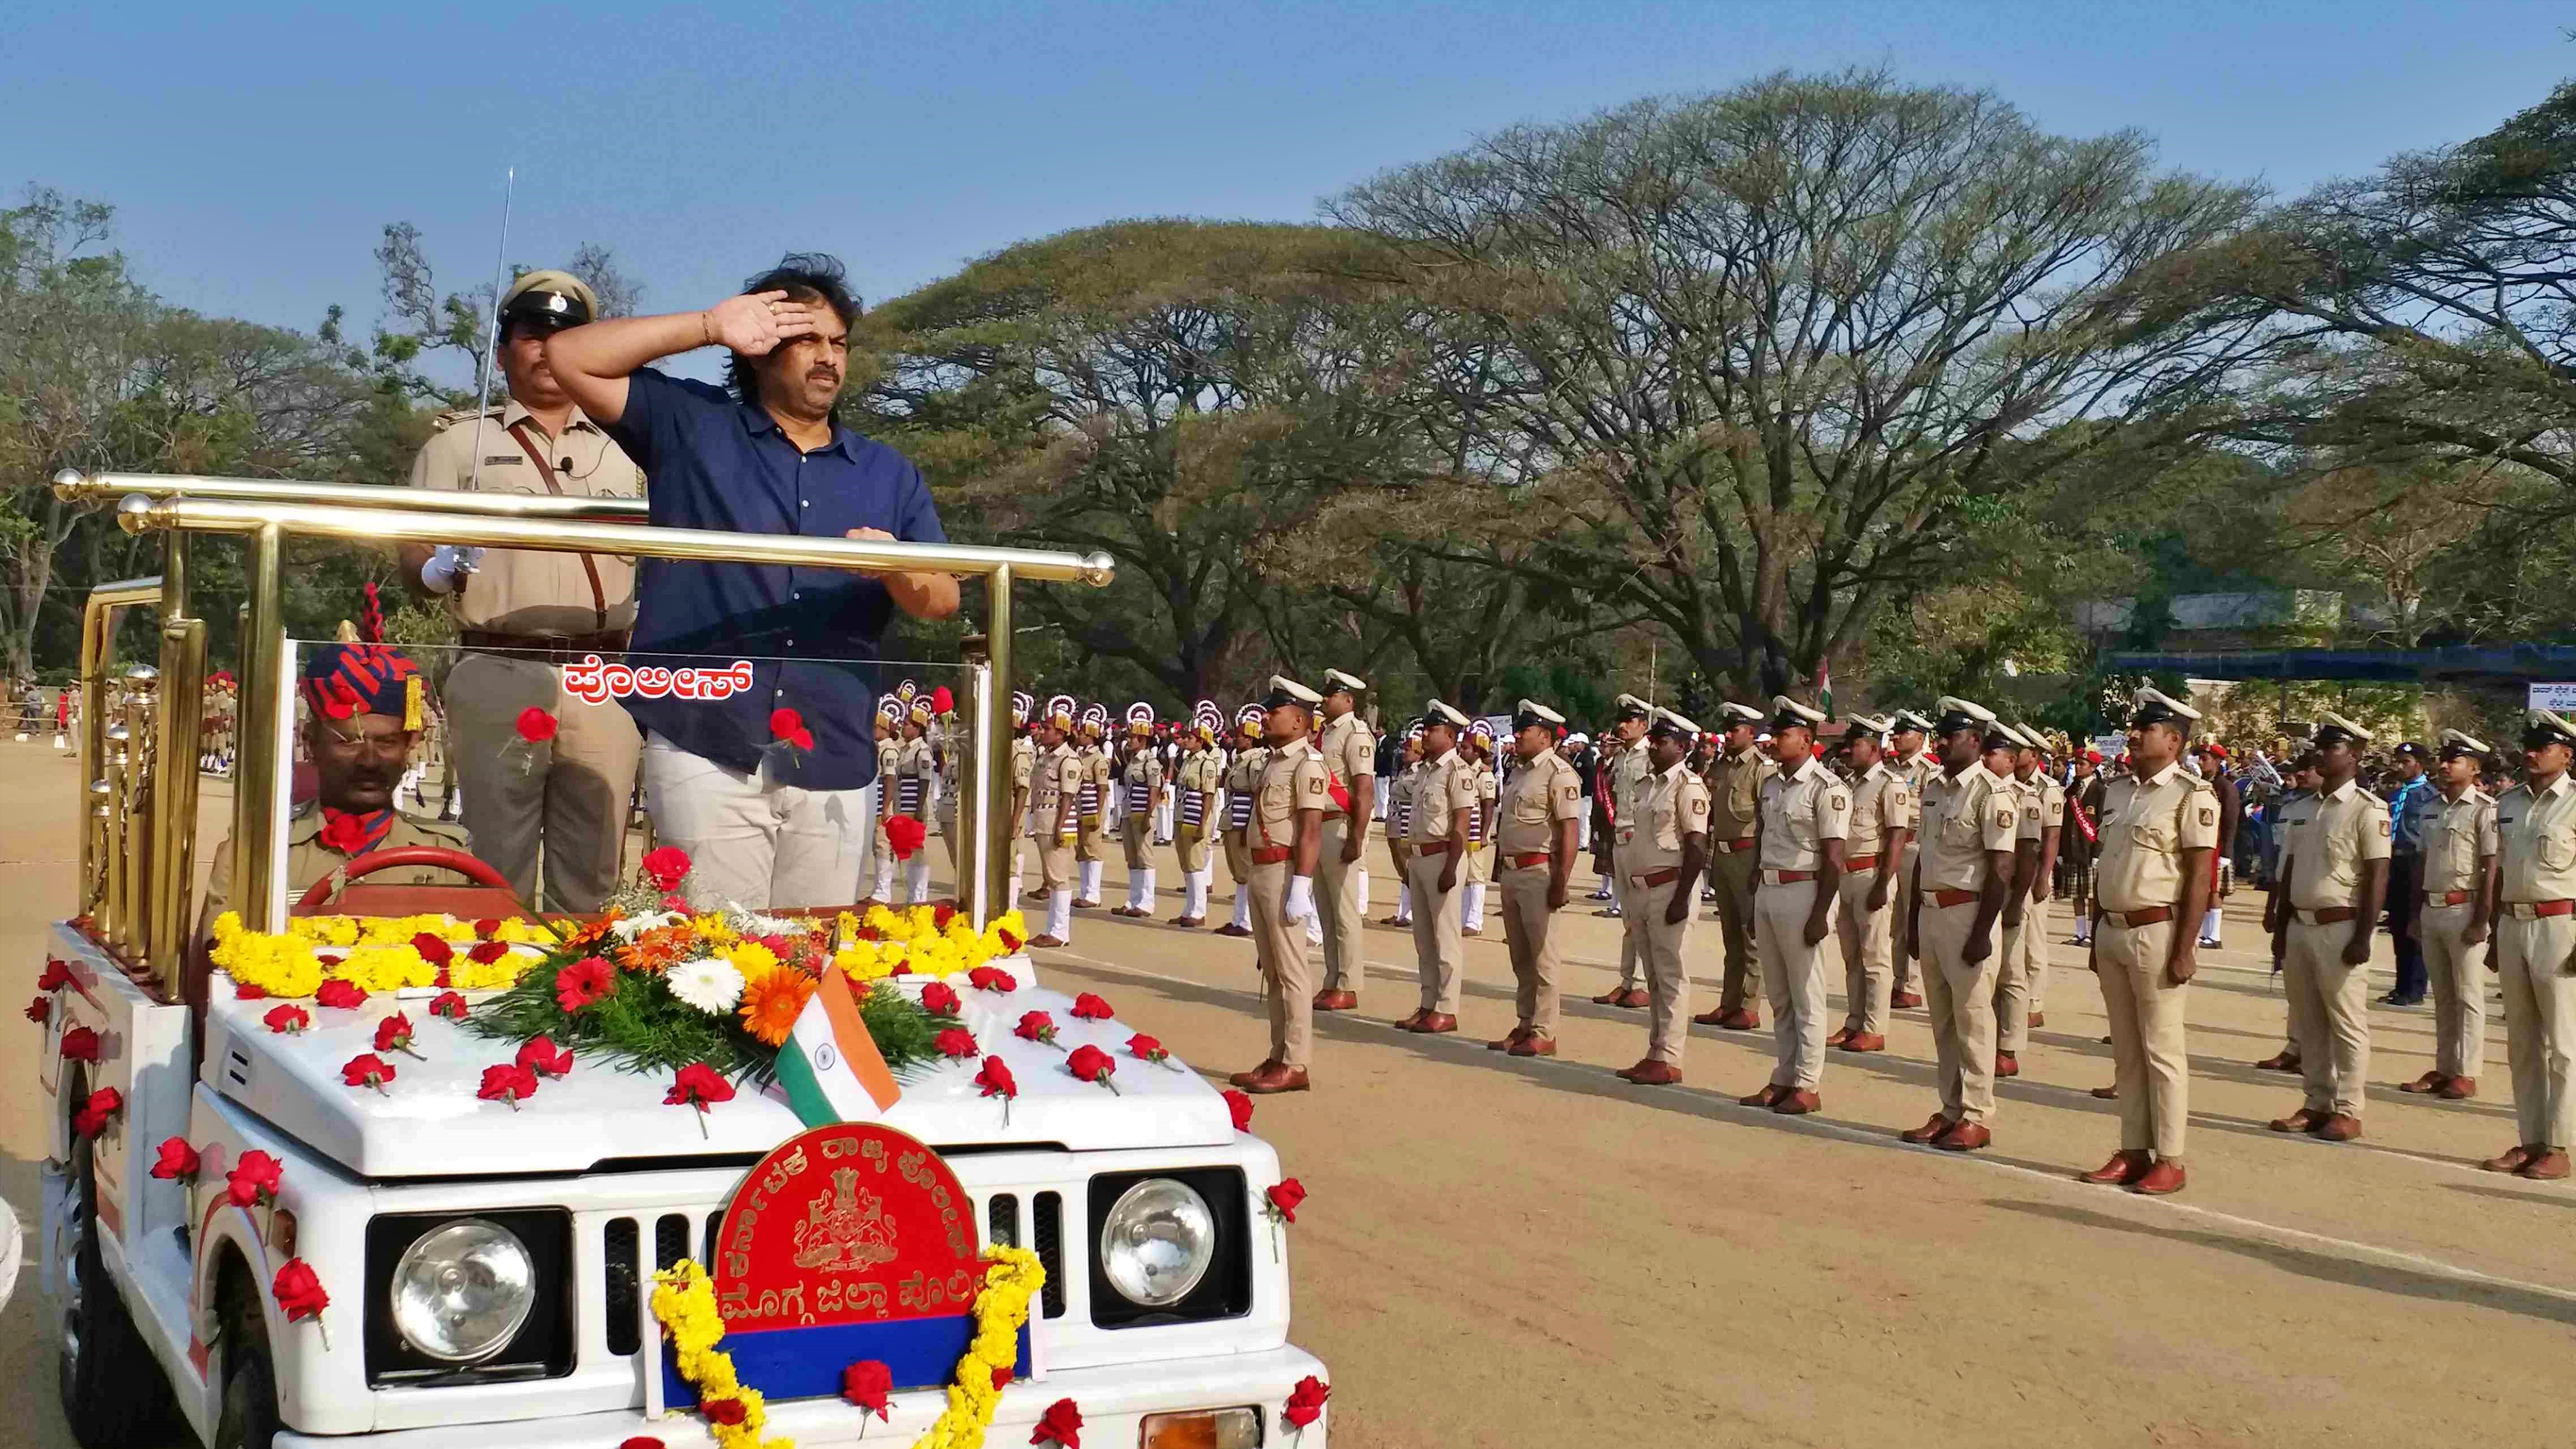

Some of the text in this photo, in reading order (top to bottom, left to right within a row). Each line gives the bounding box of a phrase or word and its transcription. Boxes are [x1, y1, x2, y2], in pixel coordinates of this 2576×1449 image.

[562, 654, 753, 706] ಪೊಲೀಸ್
[725, 1137, 972, 1277] ಕರ್ನಾಟಕ ರಾಜ್ಯ ಪೊಲೀಸ್
[714, 1269, 985, 1325] ಮೊಗ್ಗ ಜಿಲ್ಲಾ ಪೊಲೀ
